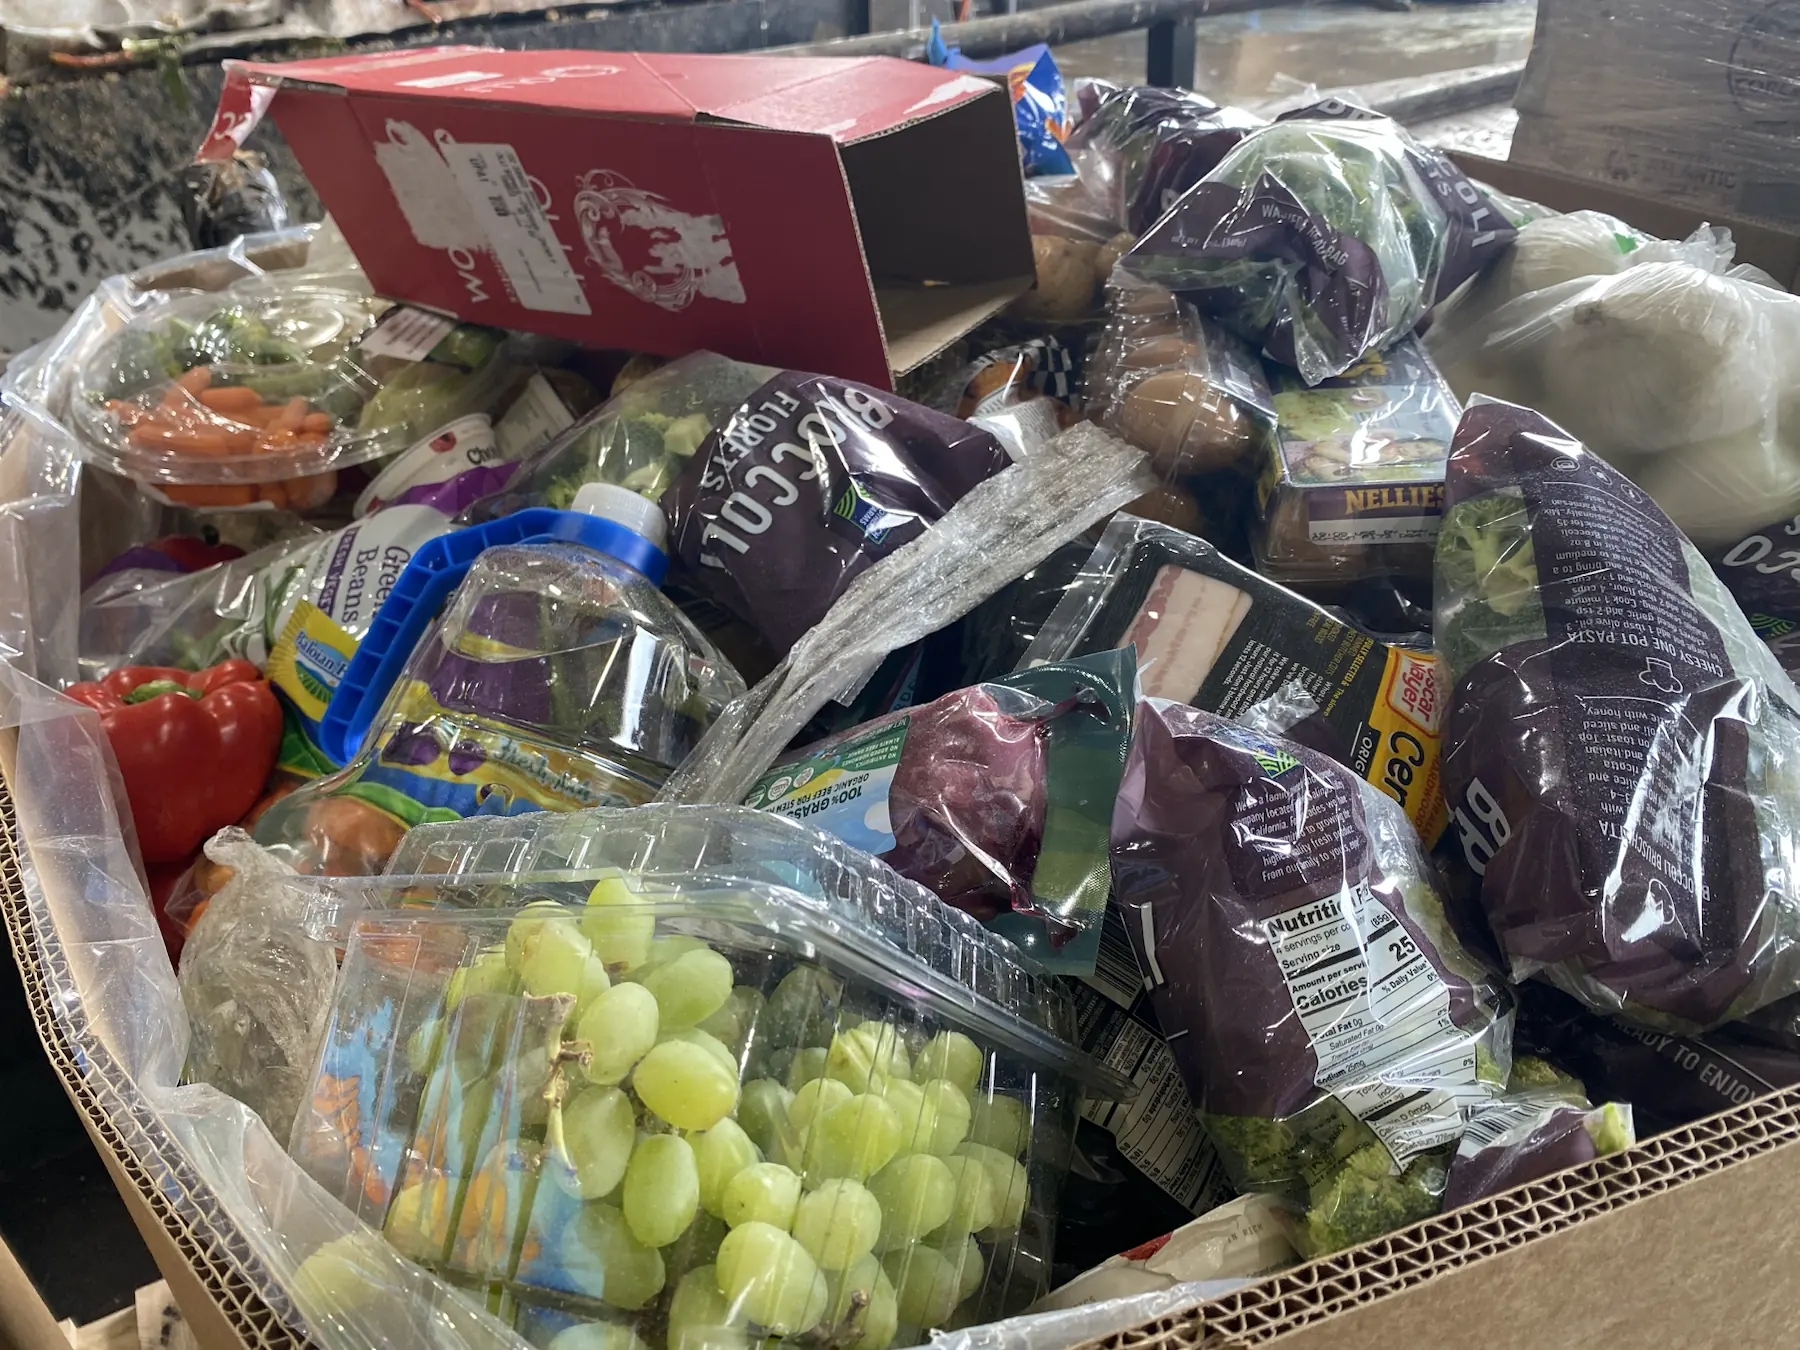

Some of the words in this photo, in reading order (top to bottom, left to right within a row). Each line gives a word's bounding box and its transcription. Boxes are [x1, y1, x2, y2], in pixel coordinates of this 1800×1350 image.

[703, 390, 801, 492] FLORETS
[1560, 529, 1601, 540] Broccoli
[1602, 533, 1619, 543] and
[1555, 549, 1597, 560] medium
[1598, 549, 1610, 558] to
[1552, 566, 1560, 575] a
[1561, 565, 1573, 574] to
[1574, 561, 1602, 573] bring
[1604, 560, 1623, 569] and
[1616, 573, 1635, 583] and
[1624, 565, 1651, 581] Whisk
[341, 545, 380, 624] Beans
[1571, 583, 1597, 595] cups
[1599, 583, 1607, 593] 4
[1564, 595, 1601, 605] minute
[1612, 595, 1637, 607] Cook
[1575, 606, 1594, 615] tsp
[1597, 606, 1604, 615] 2
[1606, 605, 1624, 615] and
[1627, 609, 1655, 621] garlic
[1565, 622, 1573, 632] 3
[1594, 618, 1620, 630] olive
[1623, 621, 1646, 634] tbsp
[1567, 629, 1616, 644] PASTA
[1621, 632, 1649, 648] POT
[1656, 627, 1672, 639] add
[1243, 639, 1257, 655] lasts
[1262, 646, 1272, 658] our
[1652, 636, 1677, 658] ONE
[1238, 654, 1248, 663] 12
[1268, 657, 1278, 667] for
[1278, 656, 1290, 667] We
[1680, 650, 1724, 679] CHEESY
[1222, 660, 1242, 687] seconds.
[1240, 660, 1253, 676] Just
[1249, 656, 1266, 681] natural
[1263, 666, 1273, 674] 12
[1269, 666, 1283, 682] take
[1286, 662, 1301, 680] we've
[1230, 674, 1245, 692] don't
[1253, 672, 1269, 690] hours
[1263, 679, 1274, 691] our
[1229, 678, 1254, 711] hardwood
[1246, 688, 1257, 703] and
[1319, 681, 1333, 697] What
[1219, 689, 1236, 710] blame
[1236, 701, 1250, 717] then
[1623, 707, 1648, 720] with
[1583, 720, 1618, 731] sliced
[1621, 721, 1641, 732] and
[1578, 732, 1601, 744] Top
[1602, 733, 1635, 745] toast.
[1637, 739, 1650, 749] on
[1585, 745, 1623, 760] Italian
[1624, 748, 1644, 761] and
[1603, 759, 1639, 775] ricotta
[833, 772, 869, 793] ORGANIC
[1588, 771, 1610, 783] and
[813, 785, 833, 801] BEEF
[834, 786, 862, 804] 100%
[1235, 801, 1247, 813] We
[1265, 803, 1294, 817] located
[1600, 802, 1624, 815] with
[1250, 820, 1289, 837] California.
[1306, 824, 1315, 835] to
[1316, 810, 1342, 831] growing
[1312, 834, 1333, 849] fresh
[1598, 818, 1662, 871] BRUSCHTTA
[1262, 867, 1285, 883] From
[1285, 864, 1299, 875] our
[1320, 852, 1330, 863] to
[1664, 863, 1711, 902] BOCCOLI
[1281, 949, 1320, 970] Serving
[1371, 911, 1393, 930] (85g)
[1284, 933, 1323, 954] servings
[1323, 928, 1340, 941] per
[1296, 976, 1369, 1011] Calories
[1388, 936, 1416, 963] 25
[1292, 976, 1326, 994] Amount
[1327, 970, 1343, 983] per
[1382, 983, 1391, 994] %
[1391, 972, 1409, 989] Daily
[1337, 1021, 1353, 1034] Fat
[1353, 1016, 1363, 1028] 0g
[1427, 971, 1438, 982] 0%
[1329, 1032, 1363, 1051] Saturated
[1363, 1027, 1375, 1039] Fat
[1315, 1067, 1347, 1086] Sodium
[1345, 1058, 1367, 1074] 25mg
[1437, 1017, 1450, 1029] 1%
[1673, 1044, 1701, 1071] TO
[1156, 1055, 1172, 1076] Sugars
[1462, 1057, 1475, 1068] 0%
[1408, 1102, 1432, 1118] 0mcg
[1403, 1128, 1423, 1141] 1mg
